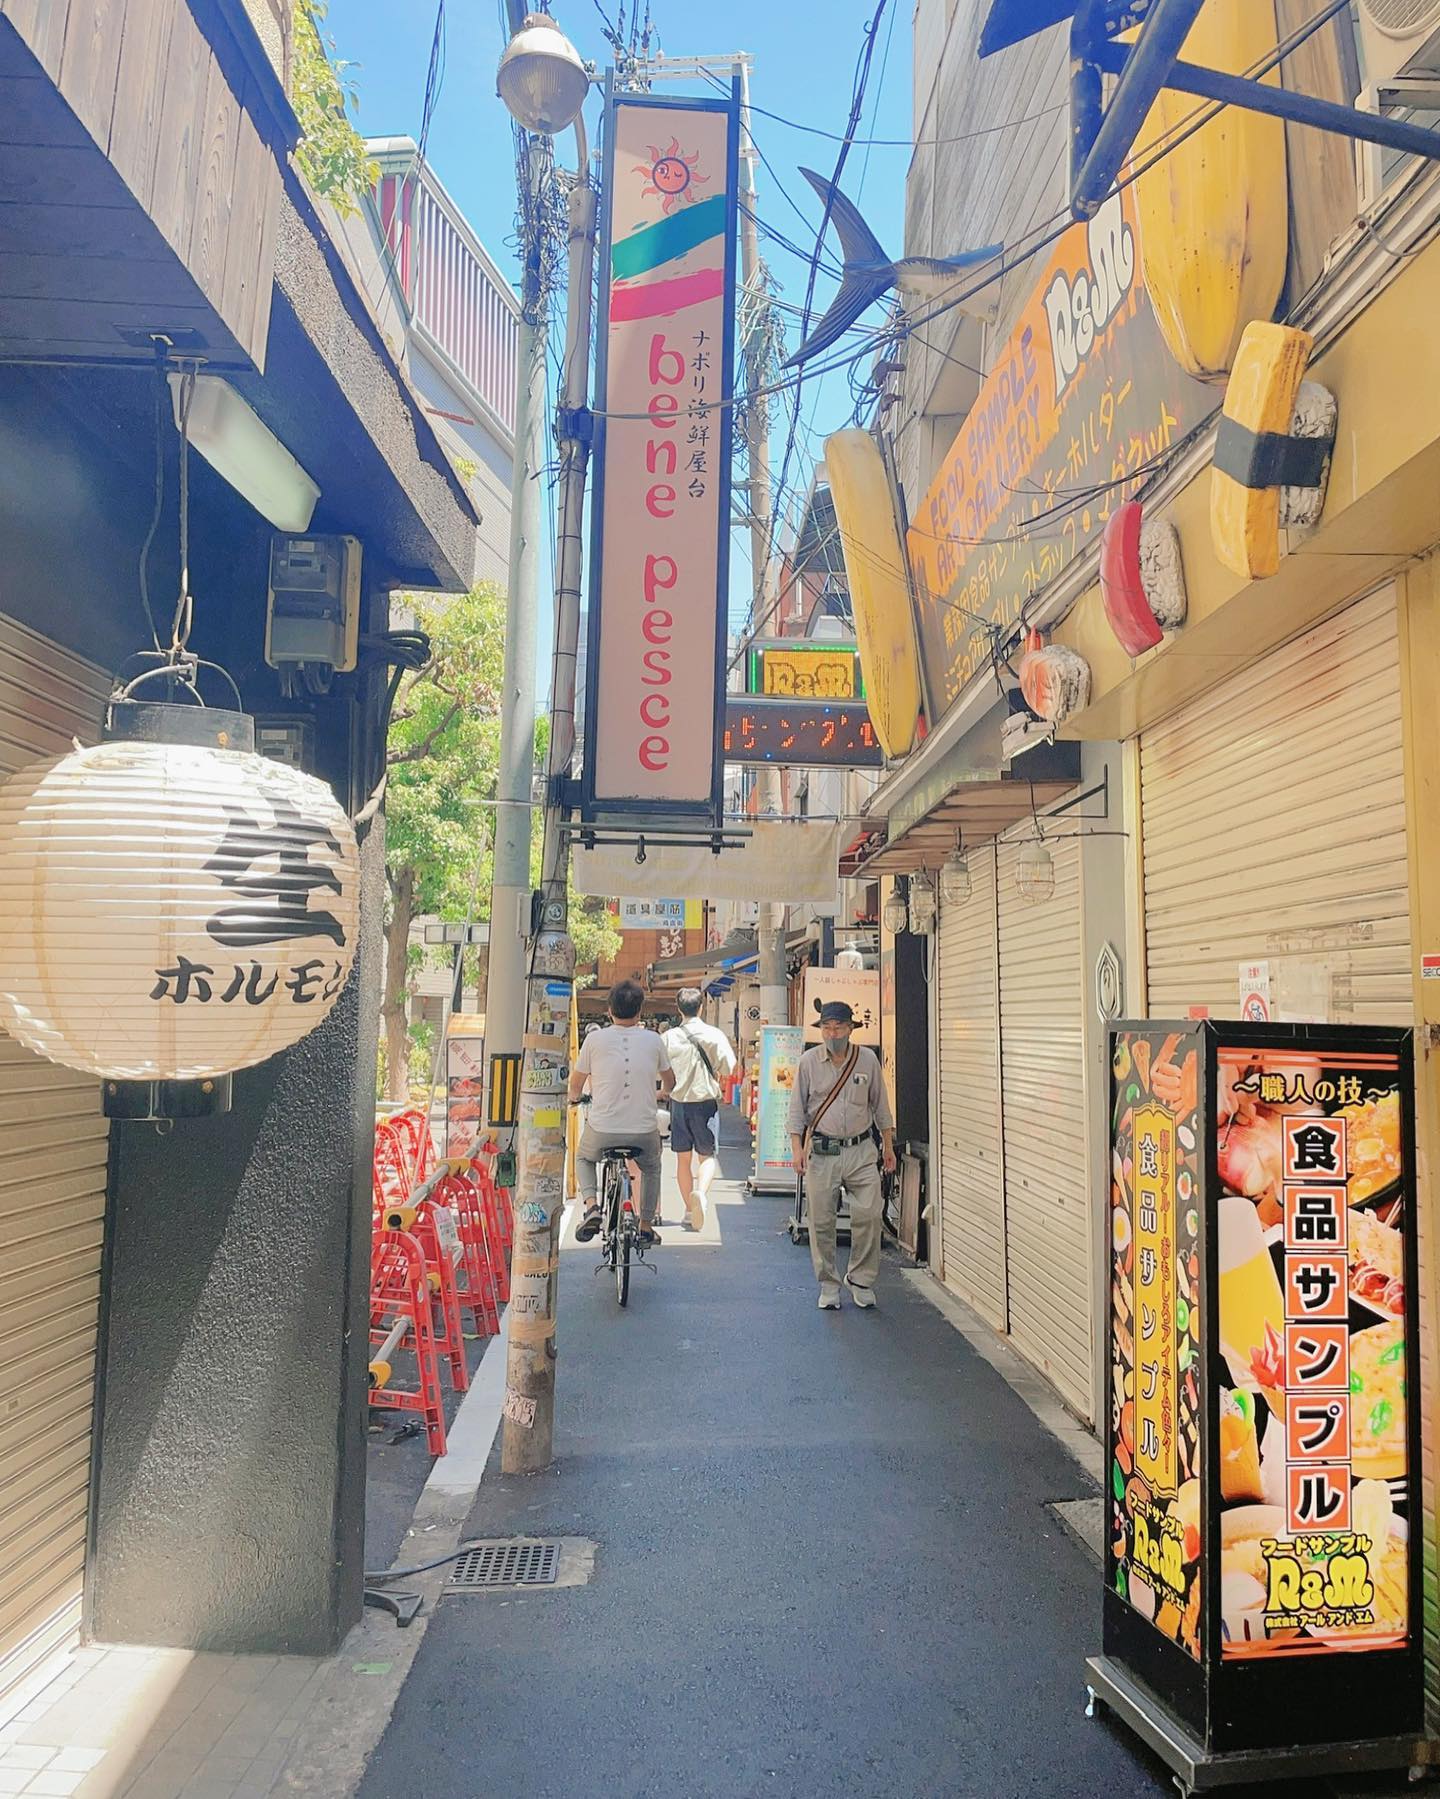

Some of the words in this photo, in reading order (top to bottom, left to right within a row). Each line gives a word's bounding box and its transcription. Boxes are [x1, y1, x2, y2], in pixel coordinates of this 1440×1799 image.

[645, 333, 686, 519] bene
[685, 330, 712, 498] ナポリ海鮮屋台
[930, 457, 965, 535] FOOD
[967, 324, 1037, 477] SAMPLE
[964, 383, 1040, 540] GALLERY
[638, 553, 678, 771] pesce
[1138, 1133, 1160, 1462] 食品サンプル
[1292, 1125, 1342, 1522] 食品サンプル
[1261, 1534, 1373, 1557] フードサンプル
[1264, 1555, 1374, 1611] R&M
